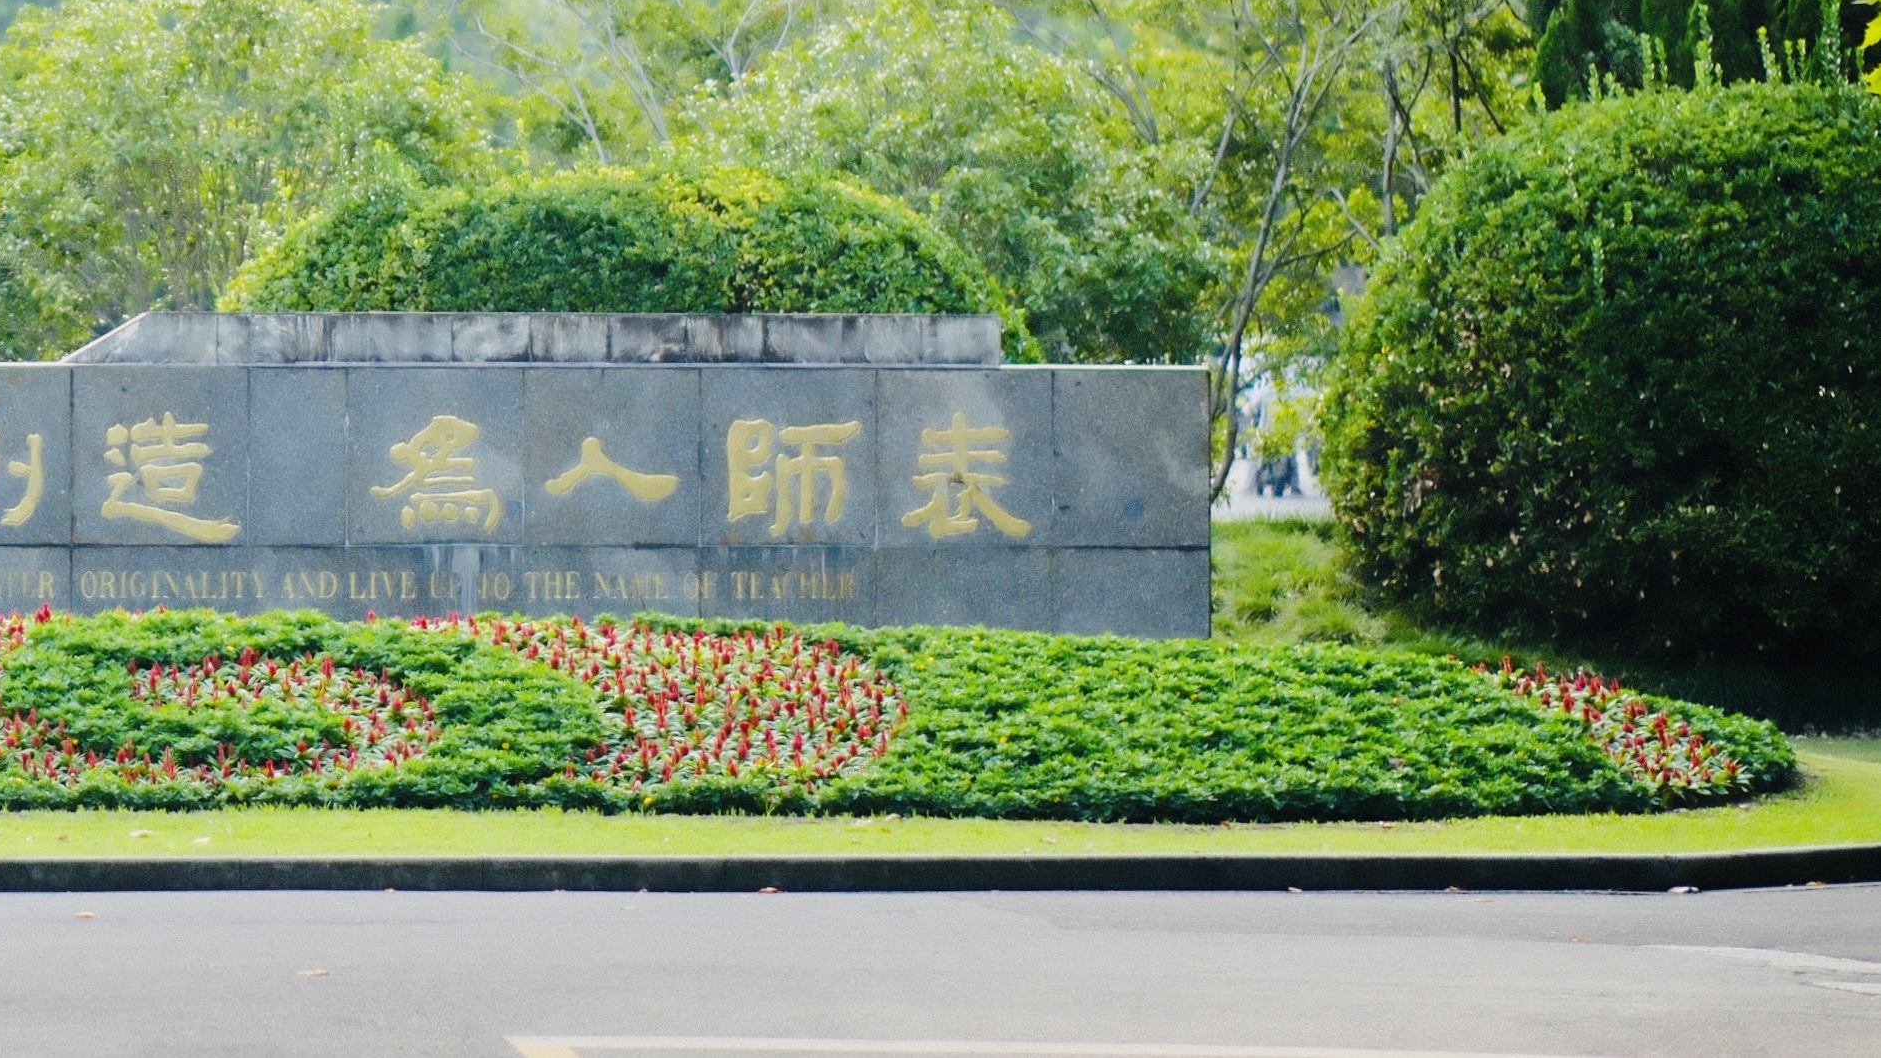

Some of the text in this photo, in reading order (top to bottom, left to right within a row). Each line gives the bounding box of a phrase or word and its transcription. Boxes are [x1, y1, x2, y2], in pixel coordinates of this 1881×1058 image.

[80, 570, 265, 599] ORIGINALITY
[279, 570, 339, 599] AND
[349, 571, 417, 599] LIVE
[524, 570, 581, 600] THE
[592, 570, 670, 600] NAME
[682, 570, 719, 600] OF
[730, 570, 856, 600] TEACHER
